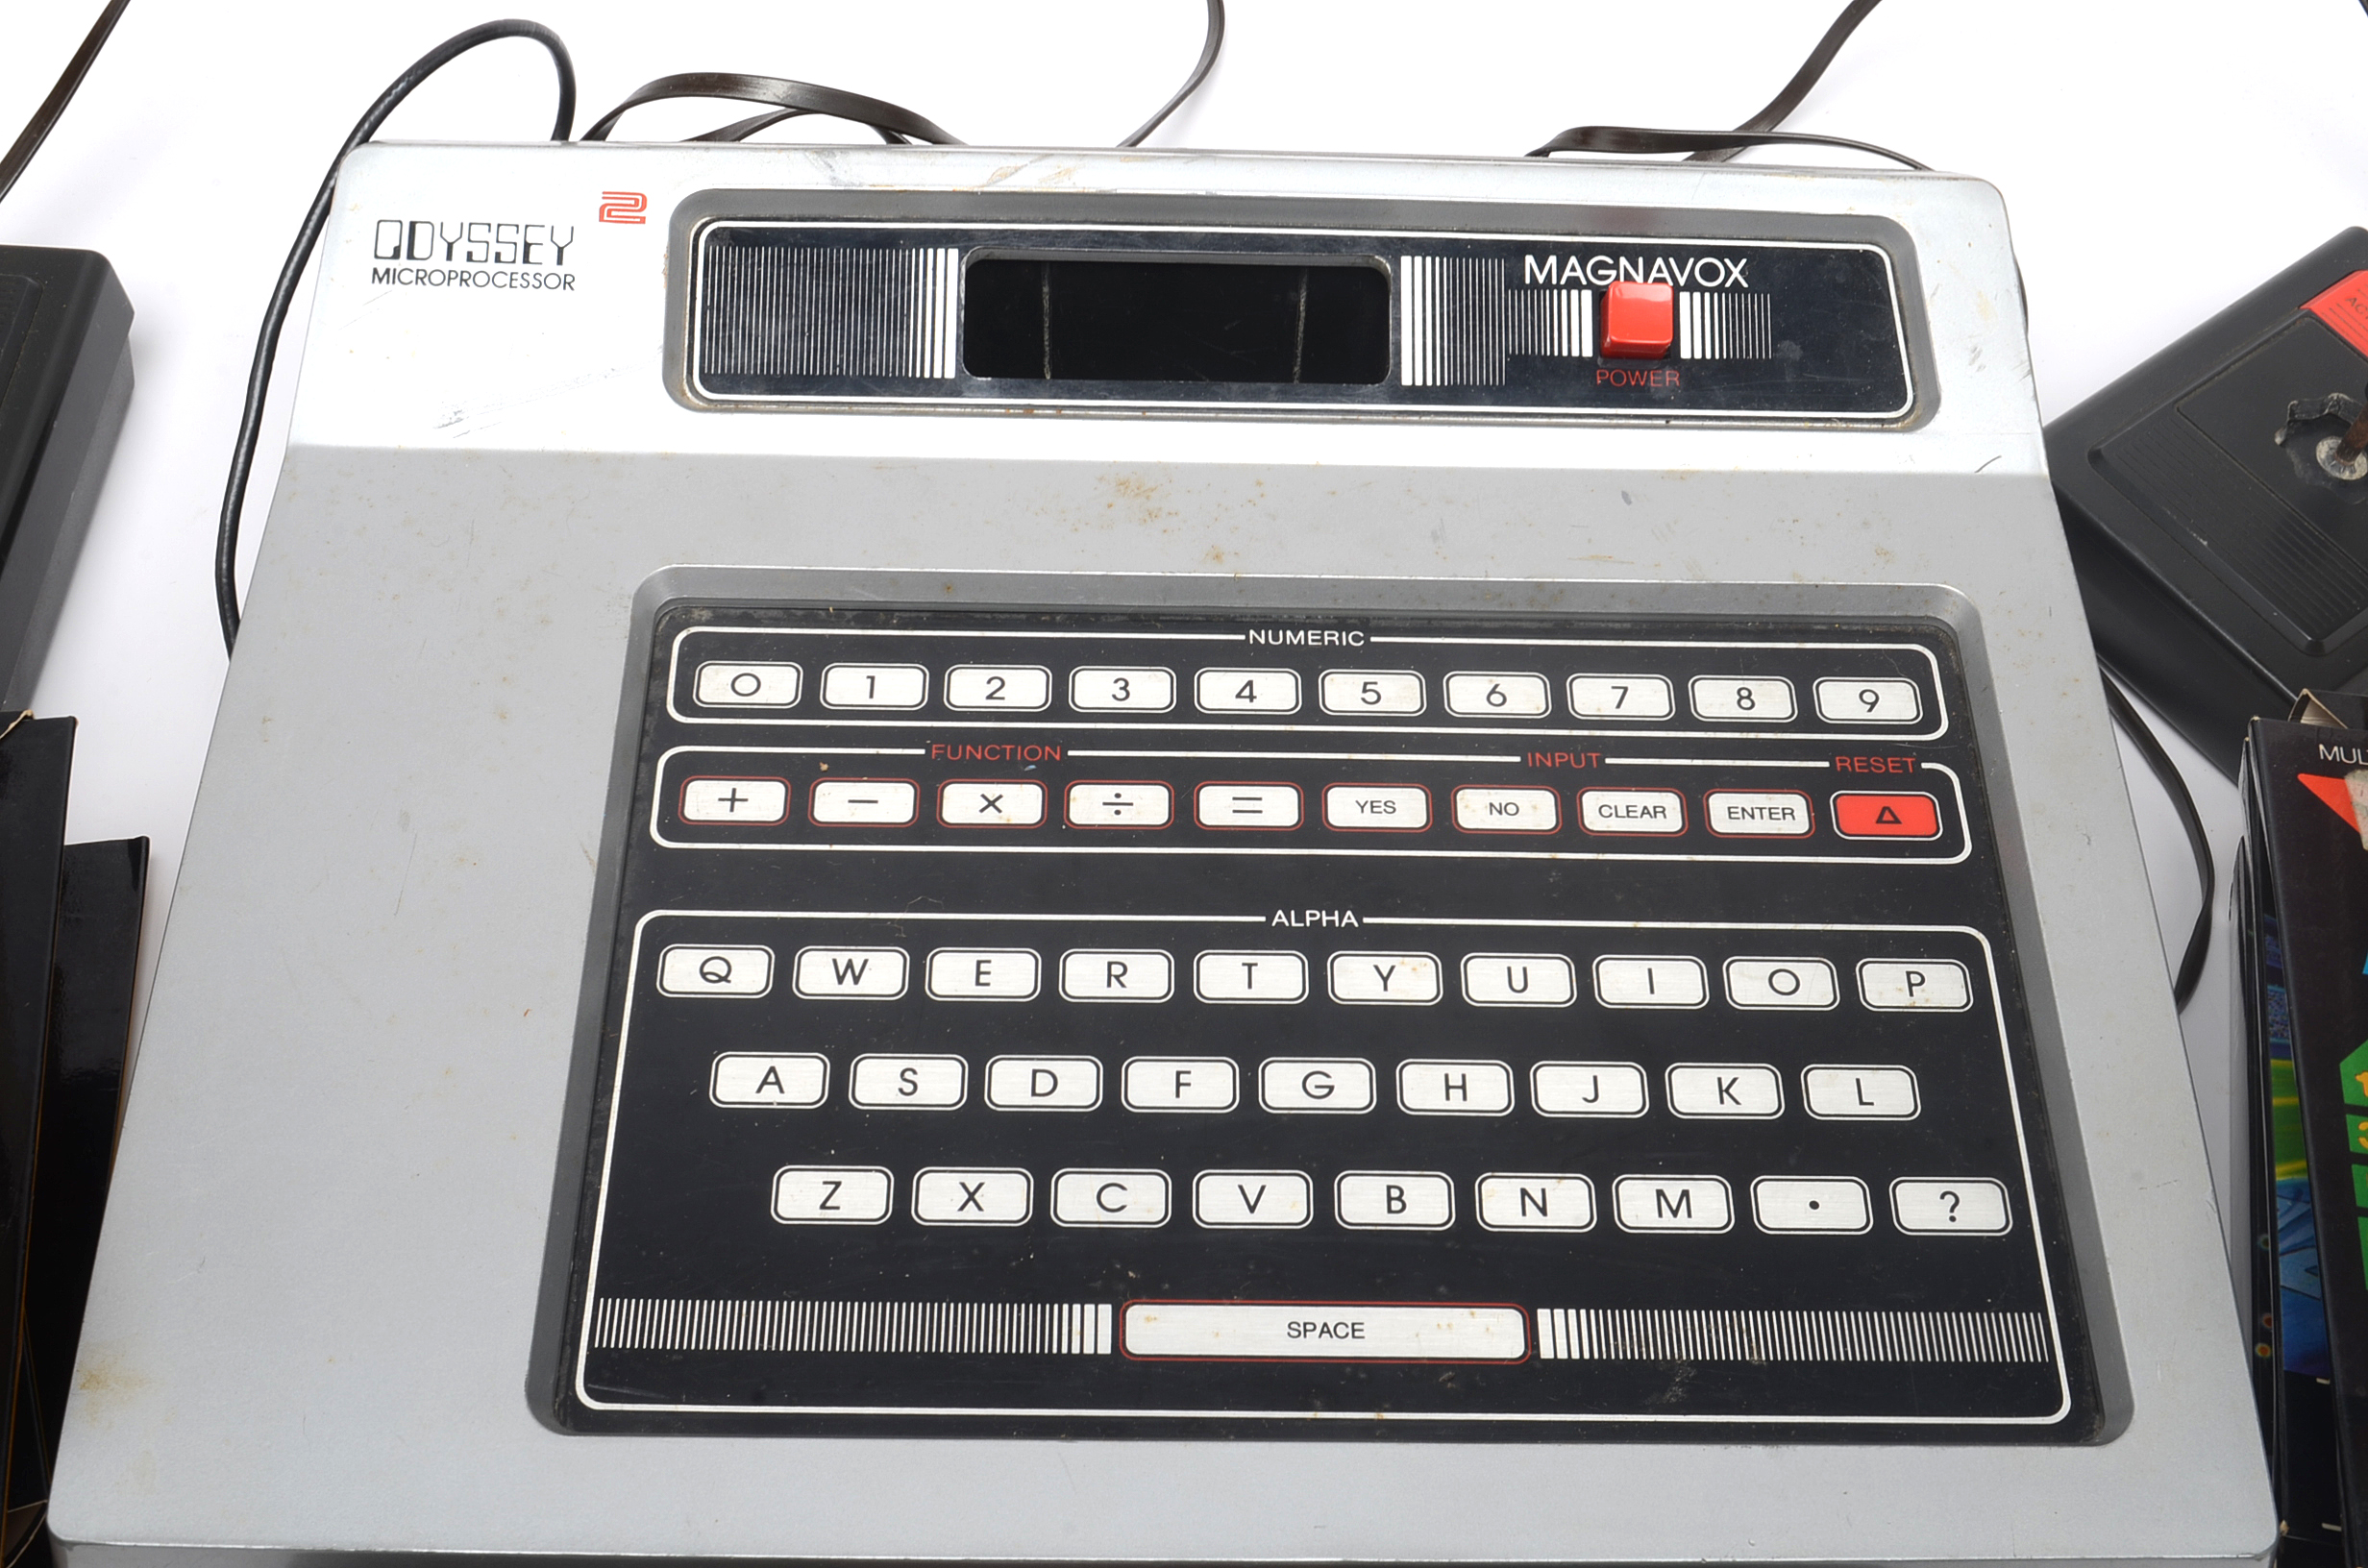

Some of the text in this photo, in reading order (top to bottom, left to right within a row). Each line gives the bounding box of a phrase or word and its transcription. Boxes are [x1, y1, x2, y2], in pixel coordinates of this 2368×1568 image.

[374, 190, 648, 266] ODYSSEY 2
[371, 266, 576, 291] MICROPROCESSOR
[1524, 254, 1749, 288] MAGNAVOX
[2345, 297, 2368, 320] AC
[1595, 369, 1680, 387] POWER
[1248, 628, 1365, 647] NUMERIC
[866, 675, 876, 699] 1
[985, 675, 1005, 700] 2
[1112, 677, 1130, 701] 3
[1235, 679, 1257, 703] 4
[1361, 681, 1382, 705] 5
[1486, 683, 1507, 707] 6
[1611, 686, 1629, 709] 7
[1737, 686, 1756, 711] 8
[1859, 689, 1880, 713] 9
[930, 743, 1061, 762] FUNCTION
[1526, 751, 1601, 769] INPUT
[2318, 743, 2368, 766] MUL
[1835, 755, 1916, 774] RESET
[1355, 800, 1396, 815] YES
[1489, 802, 1519, 817] NO
[1598, 804, 1666, 819] CLEAR
[1727, 806, 1796, 821] ENTER
[1270, 909, 1360, 928] ALPHA
[699, 956, 1926, 997] Q W E R T Y U I O P
[755, 1066, 1875, 1107] A S D F G H J K L
[819, 1181, 842, 1211] Z
[957, 1182, 985, 1212] X
[1096, 1182, 1127, 1213] C
[1238, 1184, 1267, 1214] V
[1386, 1185, 1407, 1214] B
[1519, 1188, 1548, 1217] N
[1655, 1188, 1692, 1219] M
[1939, 1190, 1961, 1223] ?
[1287, 1321, 1365, 1339] SPACE
